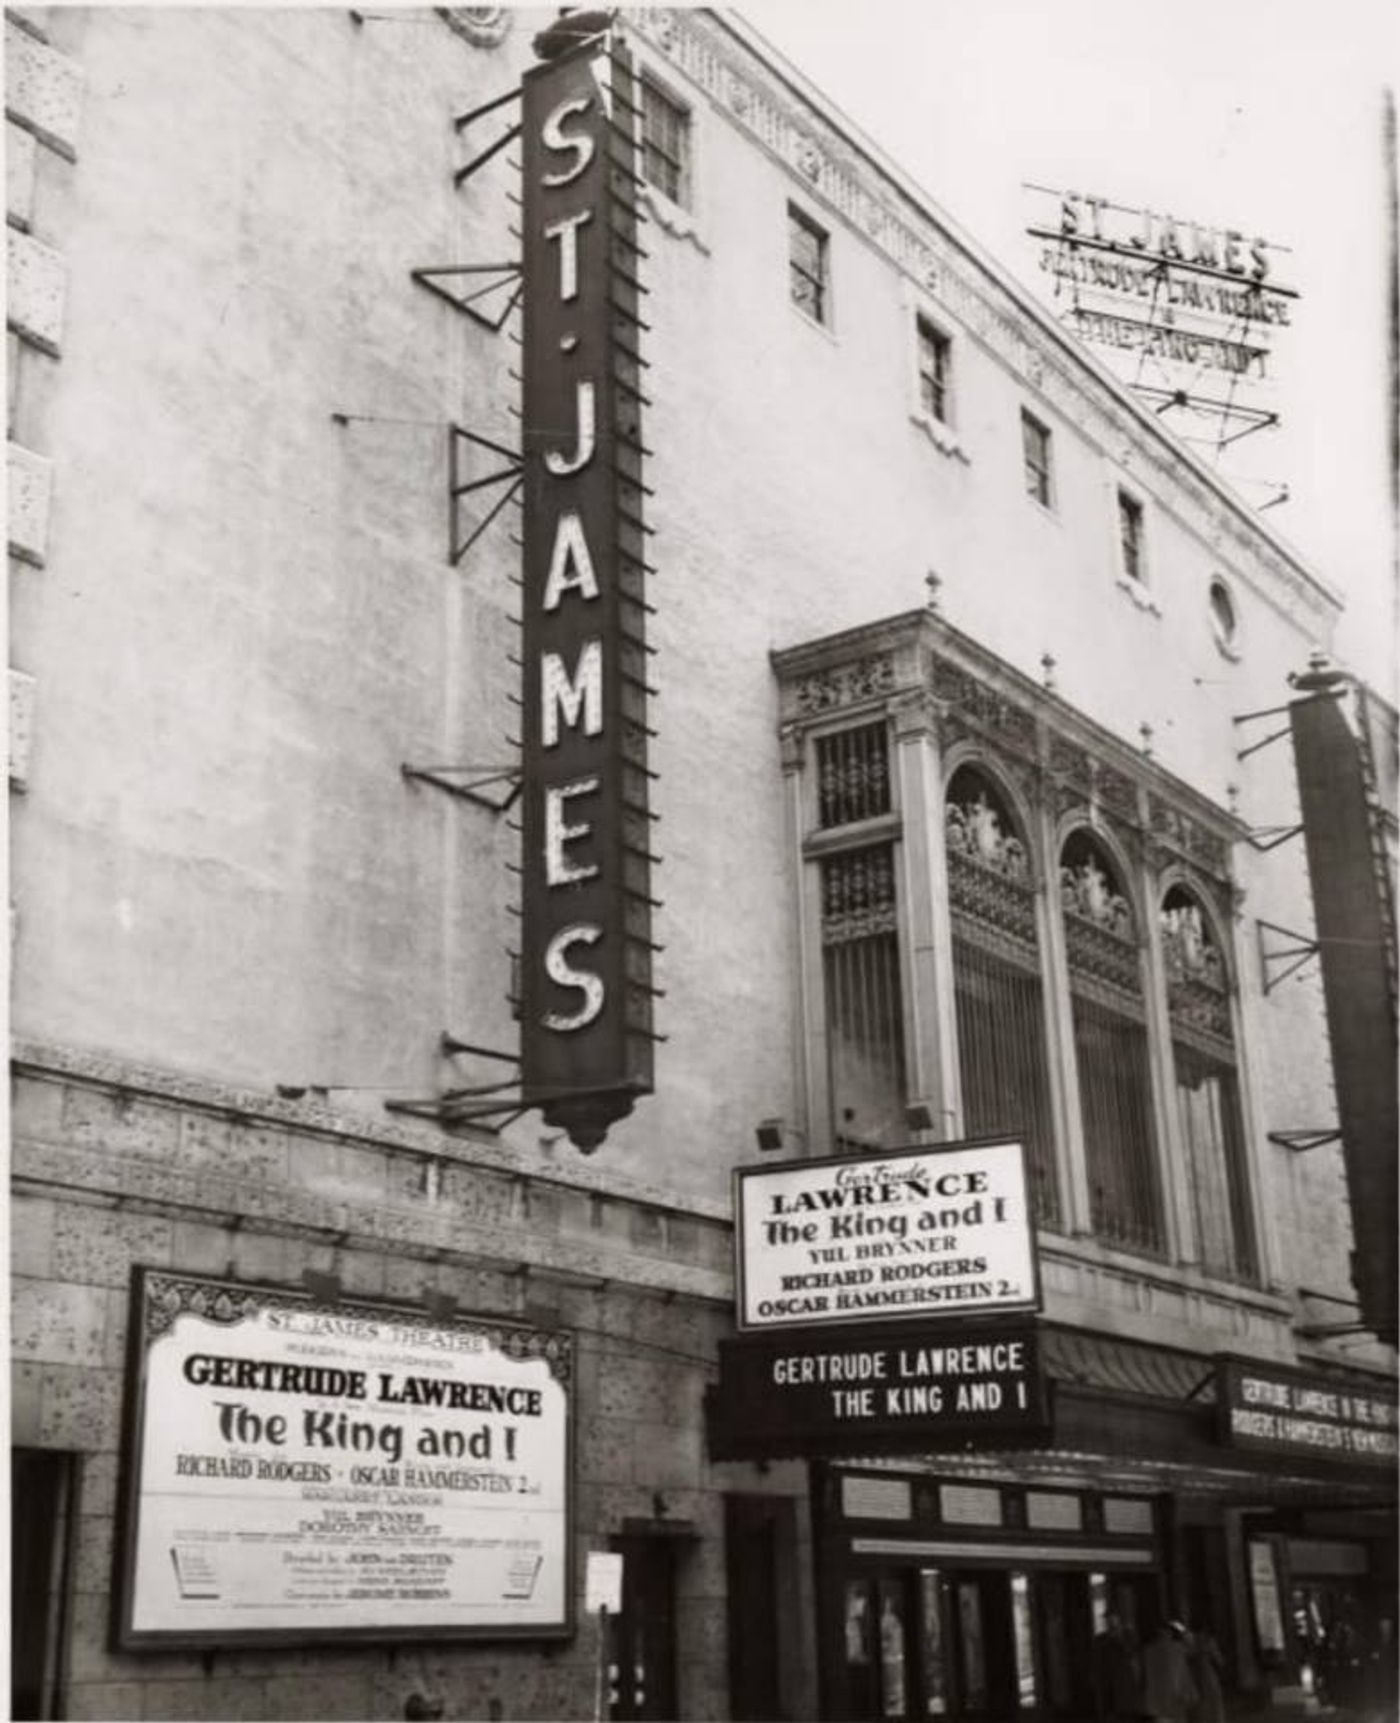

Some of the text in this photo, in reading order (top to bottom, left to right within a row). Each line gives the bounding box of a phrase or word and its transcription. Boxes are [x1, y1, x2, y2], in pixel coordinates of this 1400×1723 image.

[1130, 209, 1269, 281] JAMES
[770, 1171, 989, 1216] LAWRENCE
[762, 1197, 1007, 1247] The King and I
[808, 1235, 958, 1265] YUL BRYNNER
[781, 1257, 988, 1292] RICHARD RODGERS
[758, 1295, 829, 1318] OSCAR
[836, 1282, 992, 1311] HAMMERSTEIN
[393, 1325, 486, 1352] THEATRE
[183, 1353, 367, 1400] GERTRUDE
[378, 1373, 543, 1416] LAWRENCE
[773, 1343, 1025, 1385] GERTRUDE LAWRENCE
[832, 1381, 1027, 1418] THE KING AND I
[212, 1401, 518, 1464] The King and I
[176, 1453, 252, 1480] RICHARD
[257, 1458, 332, 1483] RODGERS
[350, 1463, 400, 1488] OSCAR
[404, 1467, 515, 1494] HAMMERSTEIN
